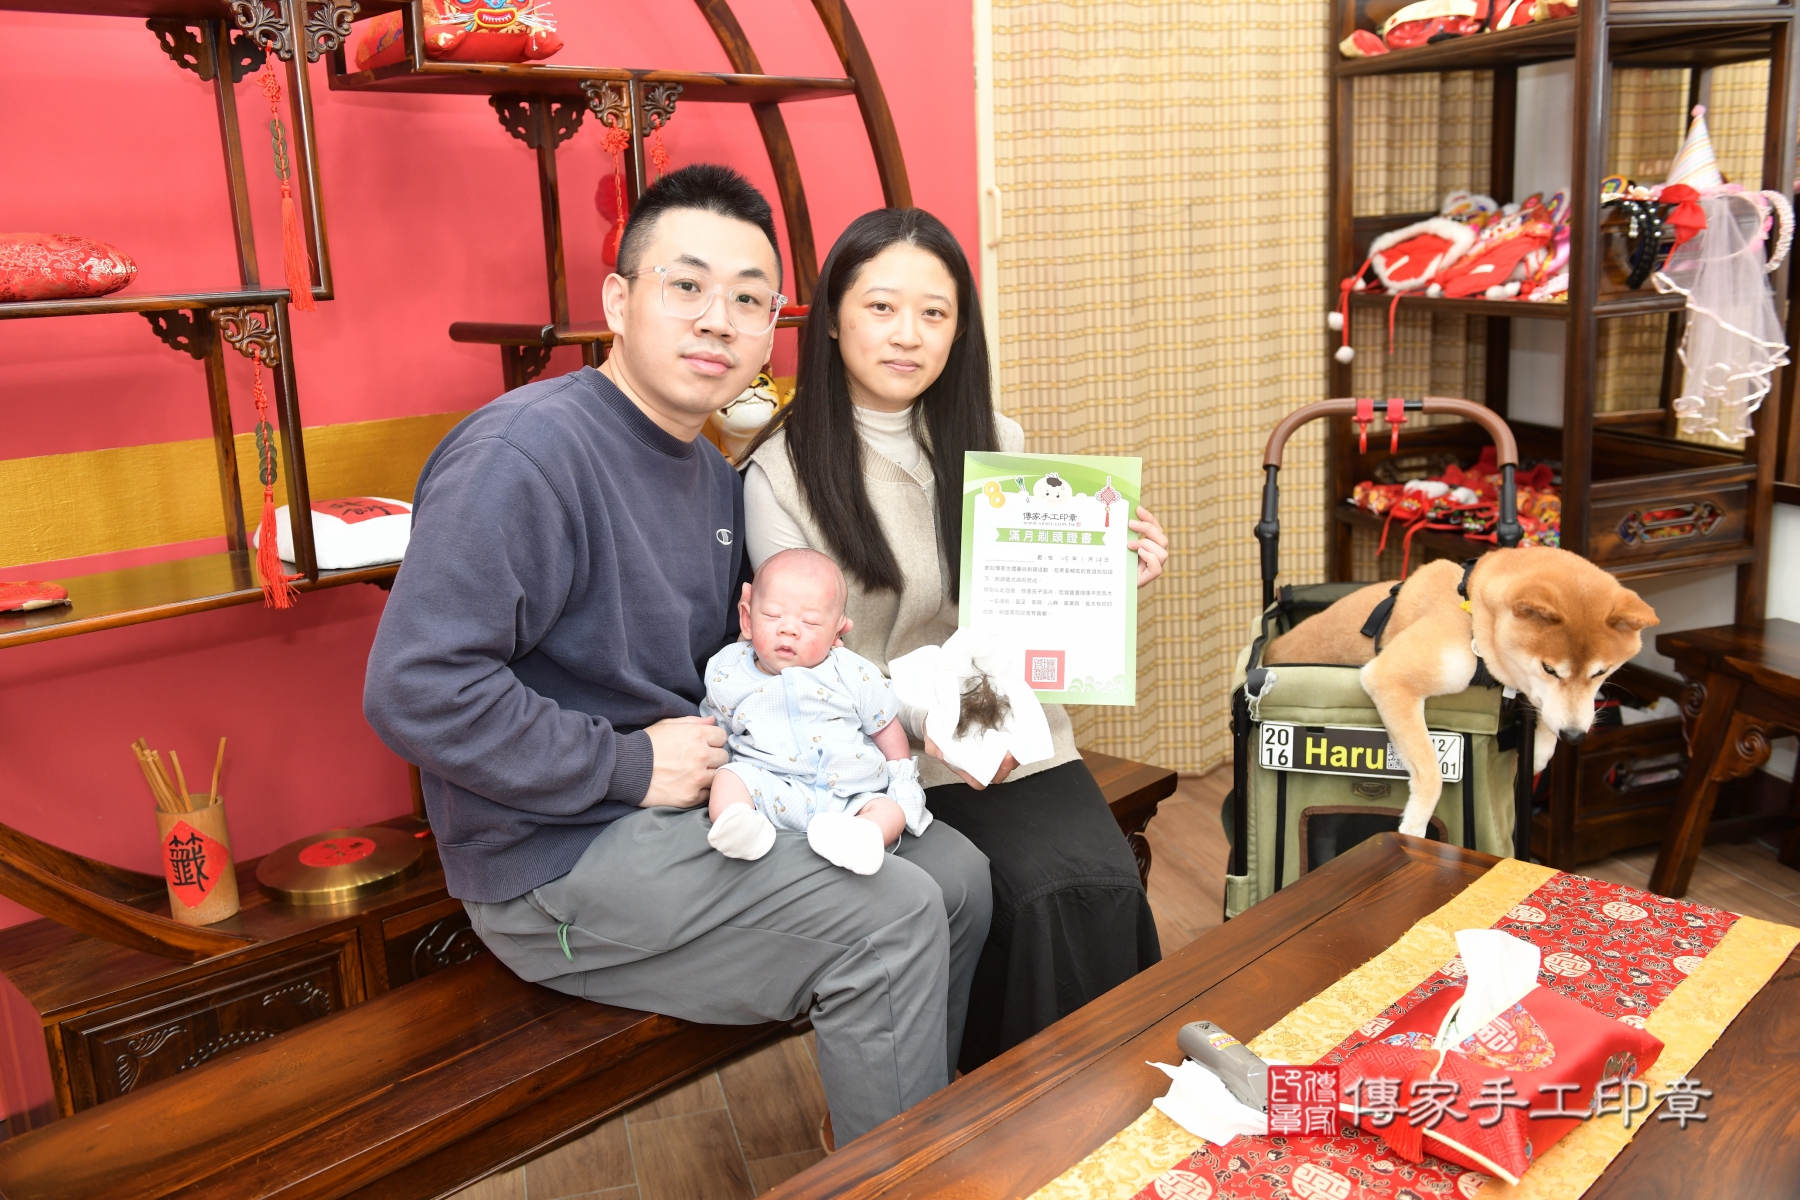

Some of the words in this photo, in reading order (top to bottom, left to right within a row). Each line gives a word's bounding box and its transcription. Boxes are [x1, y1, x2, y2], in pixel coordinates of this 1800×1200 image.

[1023, 512, 1077, 522] 傳家手工印章
[1009, 529, 1093, 544] 滿月剃頭證書
[1265, 727, 1289, 746] 20
[1265, 748, 1289, 766] 16
[1305, 736, 1384, 770] Haru
[1441, 761, 1456, 775] 01
